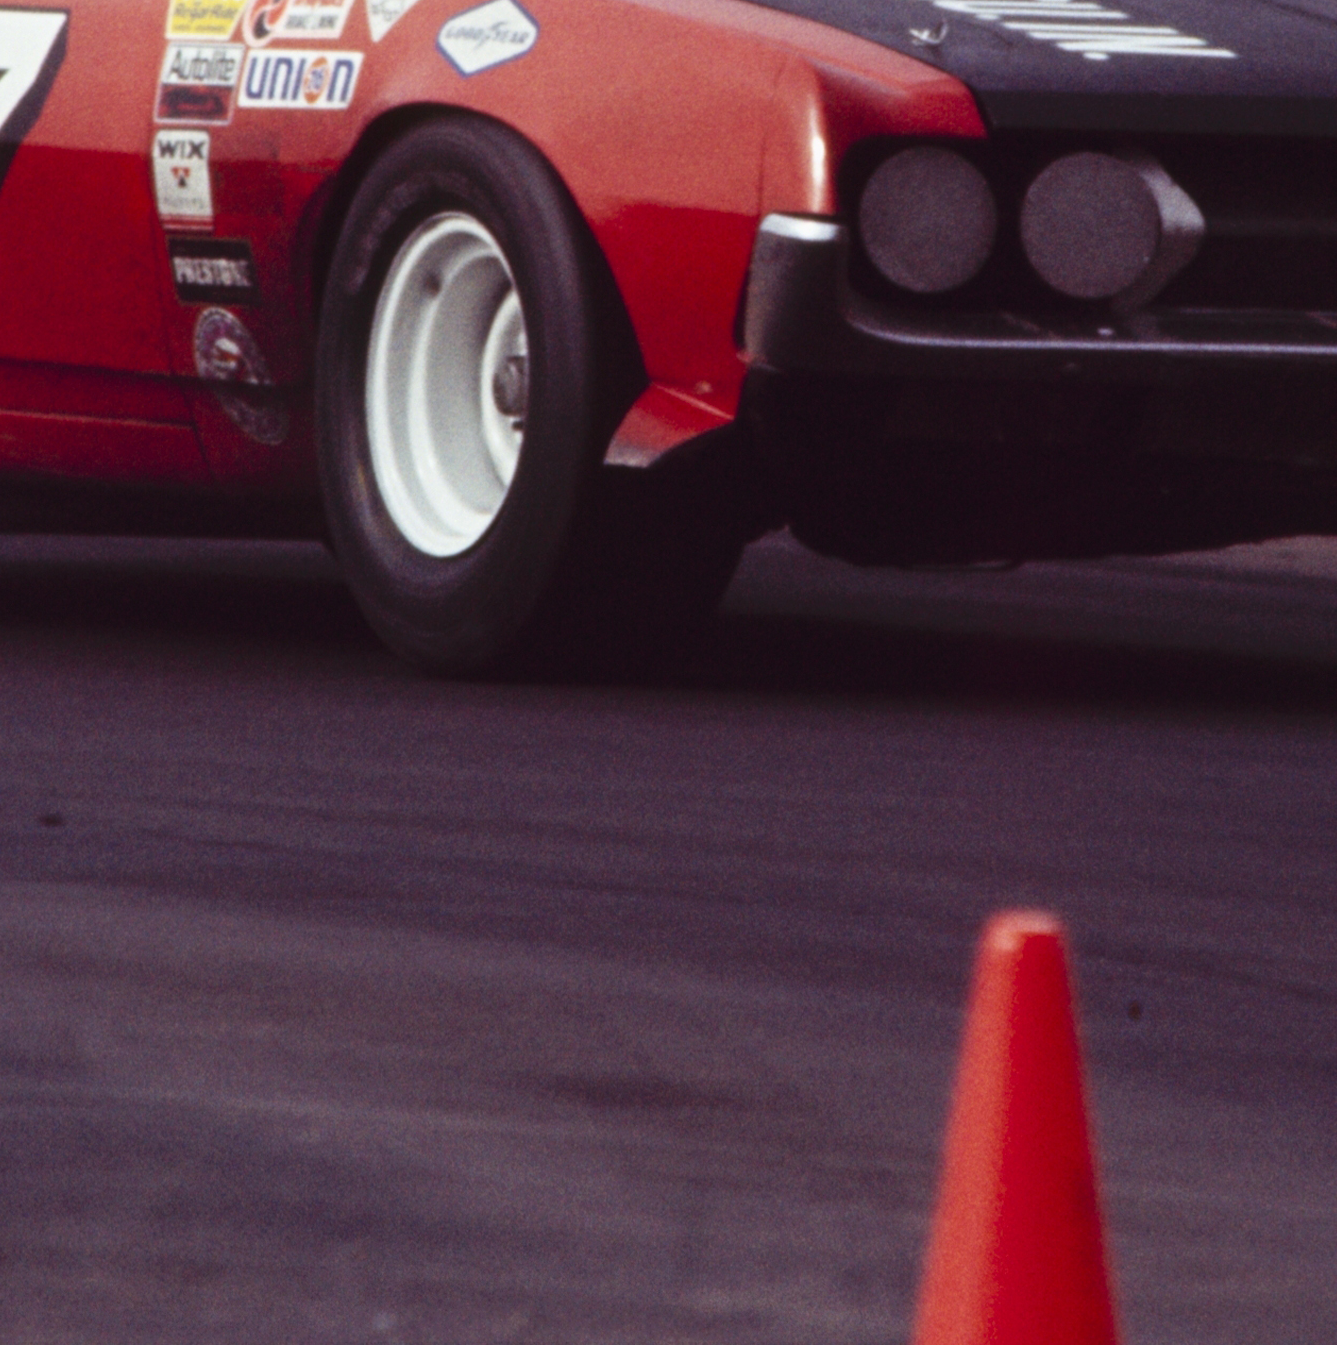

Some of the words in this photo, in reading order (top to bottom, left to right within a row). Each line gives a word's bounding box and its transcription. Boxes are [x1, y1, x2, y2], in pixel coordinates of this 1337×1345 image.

[167, 49, 238, 82] Autolite
[245, 55, 355, 105] UNION
[157, 140, 205, 159] WIX
